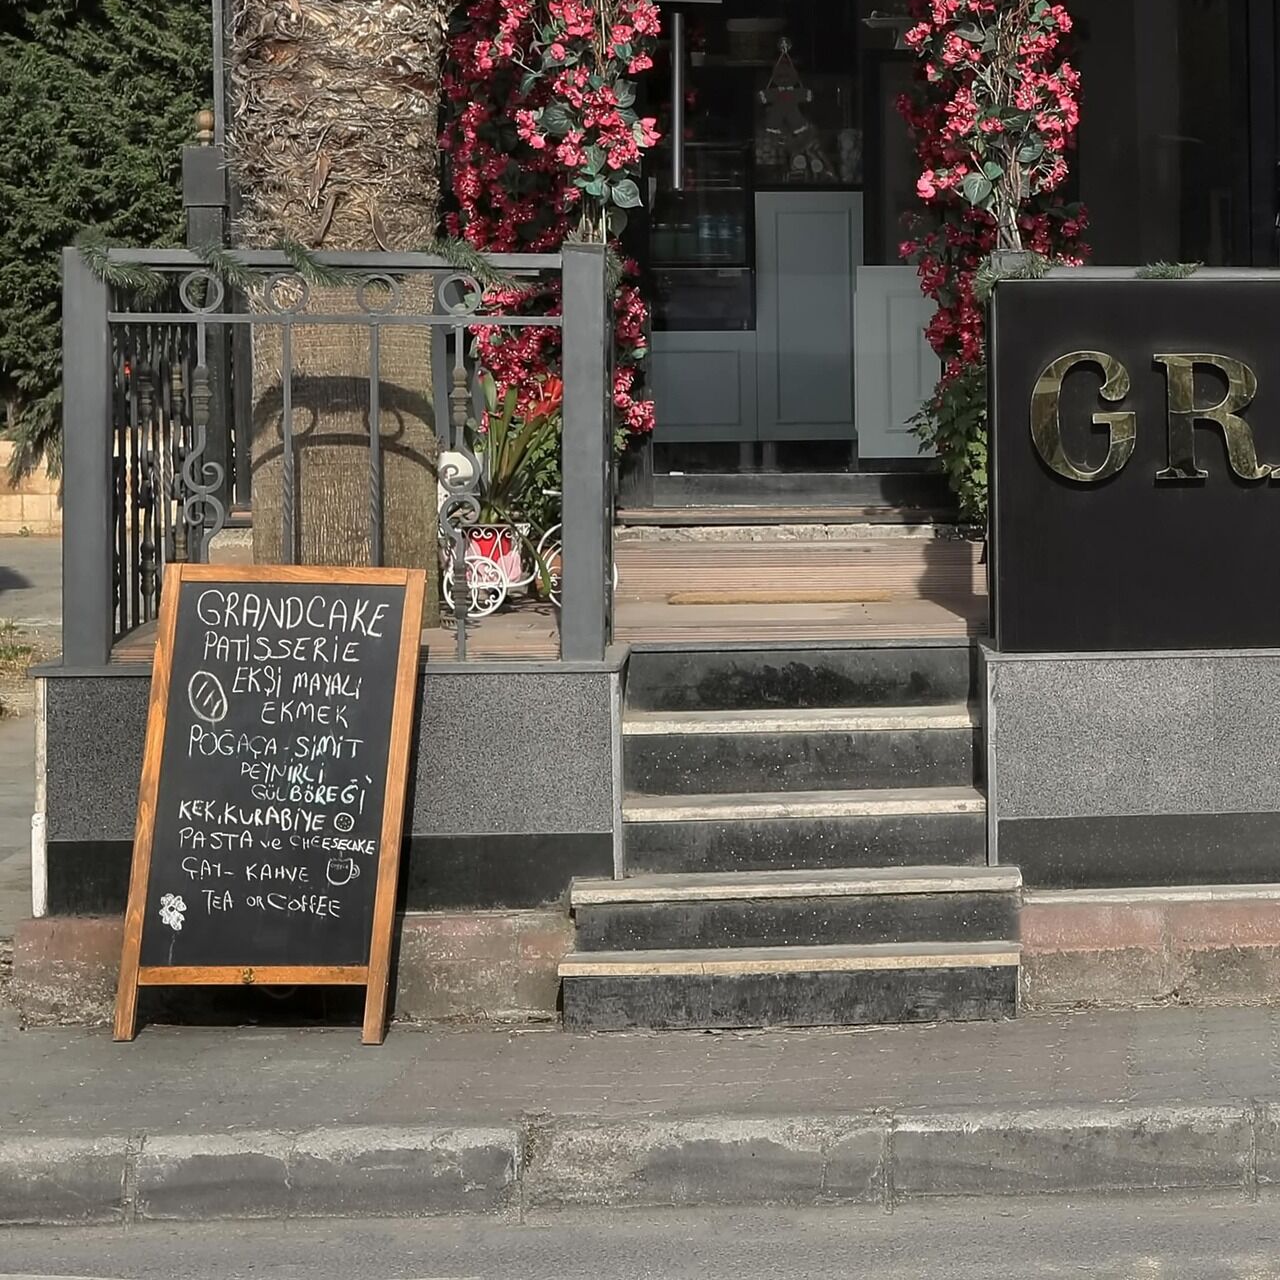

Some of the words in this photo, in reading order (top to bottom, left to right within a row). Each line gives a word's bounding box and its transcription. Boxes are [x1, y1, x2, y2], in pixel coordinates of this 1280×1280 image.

[197, 589, 389, 637] GRANDCAKE
[261, 700, 348, 728] EKMEK
[178, 827, 253, 851] PASTA
[246, 863, 309, 882] KAHVE
[201, 889, 233, 915] TEA
[246, 895, 266, 911] OR
